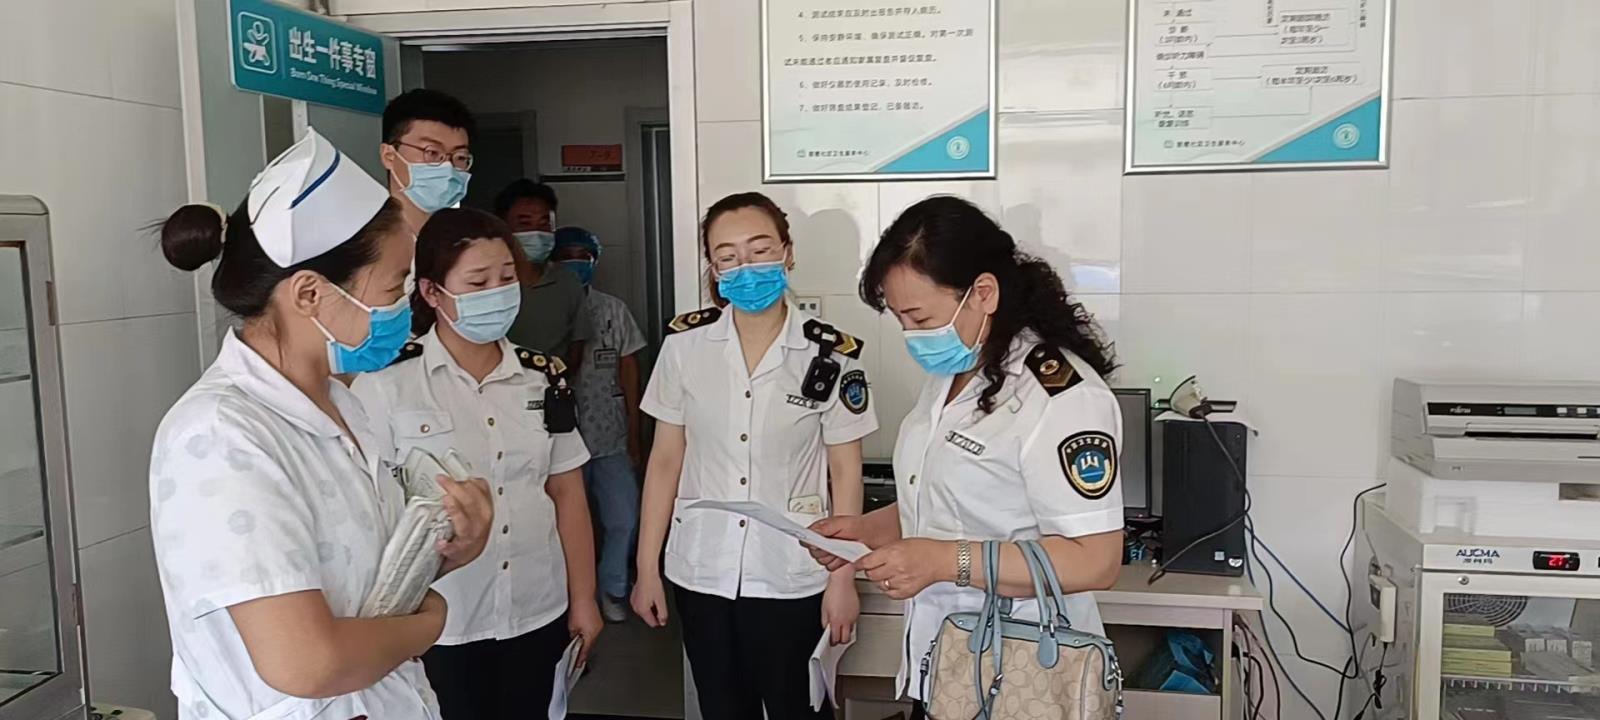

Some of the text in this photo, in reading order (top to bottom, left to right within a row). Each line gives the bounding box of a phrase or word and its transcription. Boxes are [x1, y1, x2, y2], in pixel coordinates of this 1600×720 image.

[288, 26, 376, 79] 出生一件事专窗
[1456, 549, 1500, 558] AUCMA
